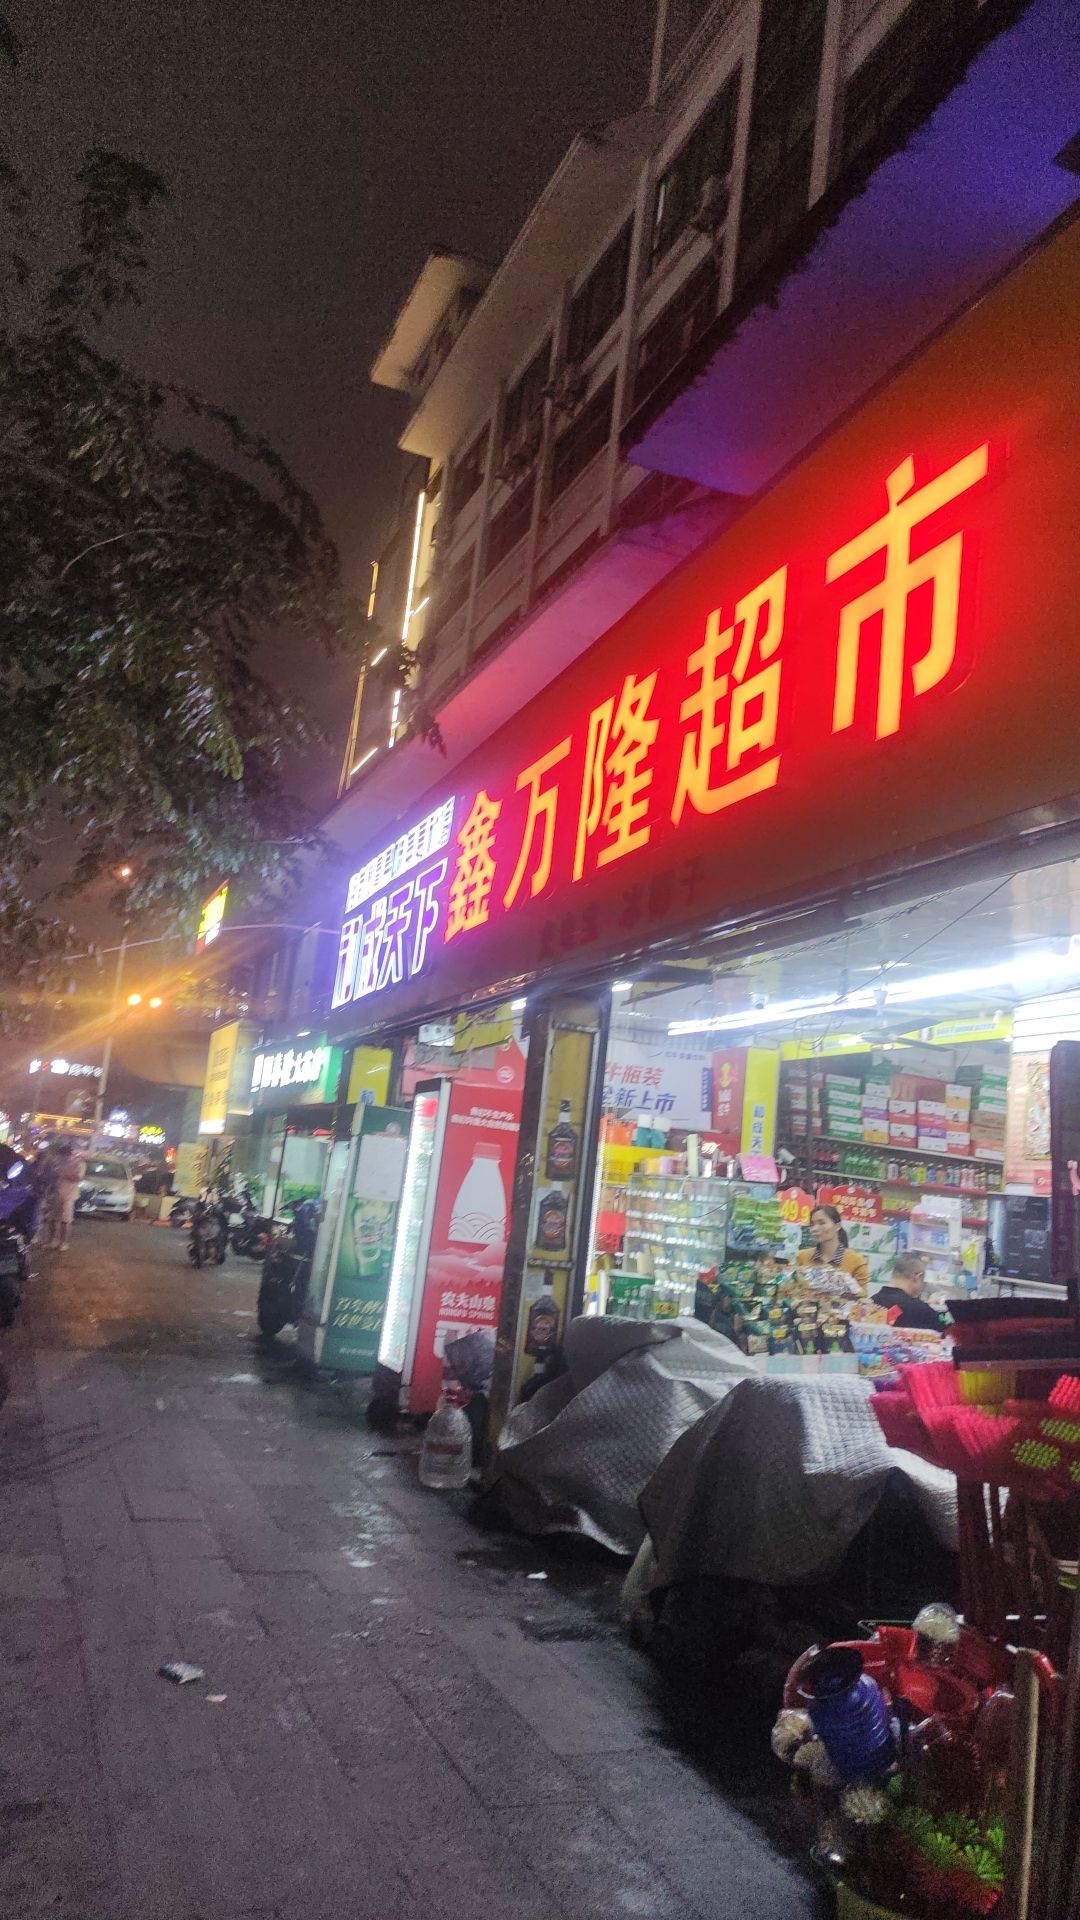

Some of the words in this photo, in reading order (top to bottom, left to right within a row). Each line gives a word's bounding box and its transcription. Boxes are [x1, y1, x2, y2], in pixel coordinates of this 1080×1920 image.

[443, 440, 990, 943] 鑫万隆超市
[440, 1291, 496, 1312] 农夫山泉
